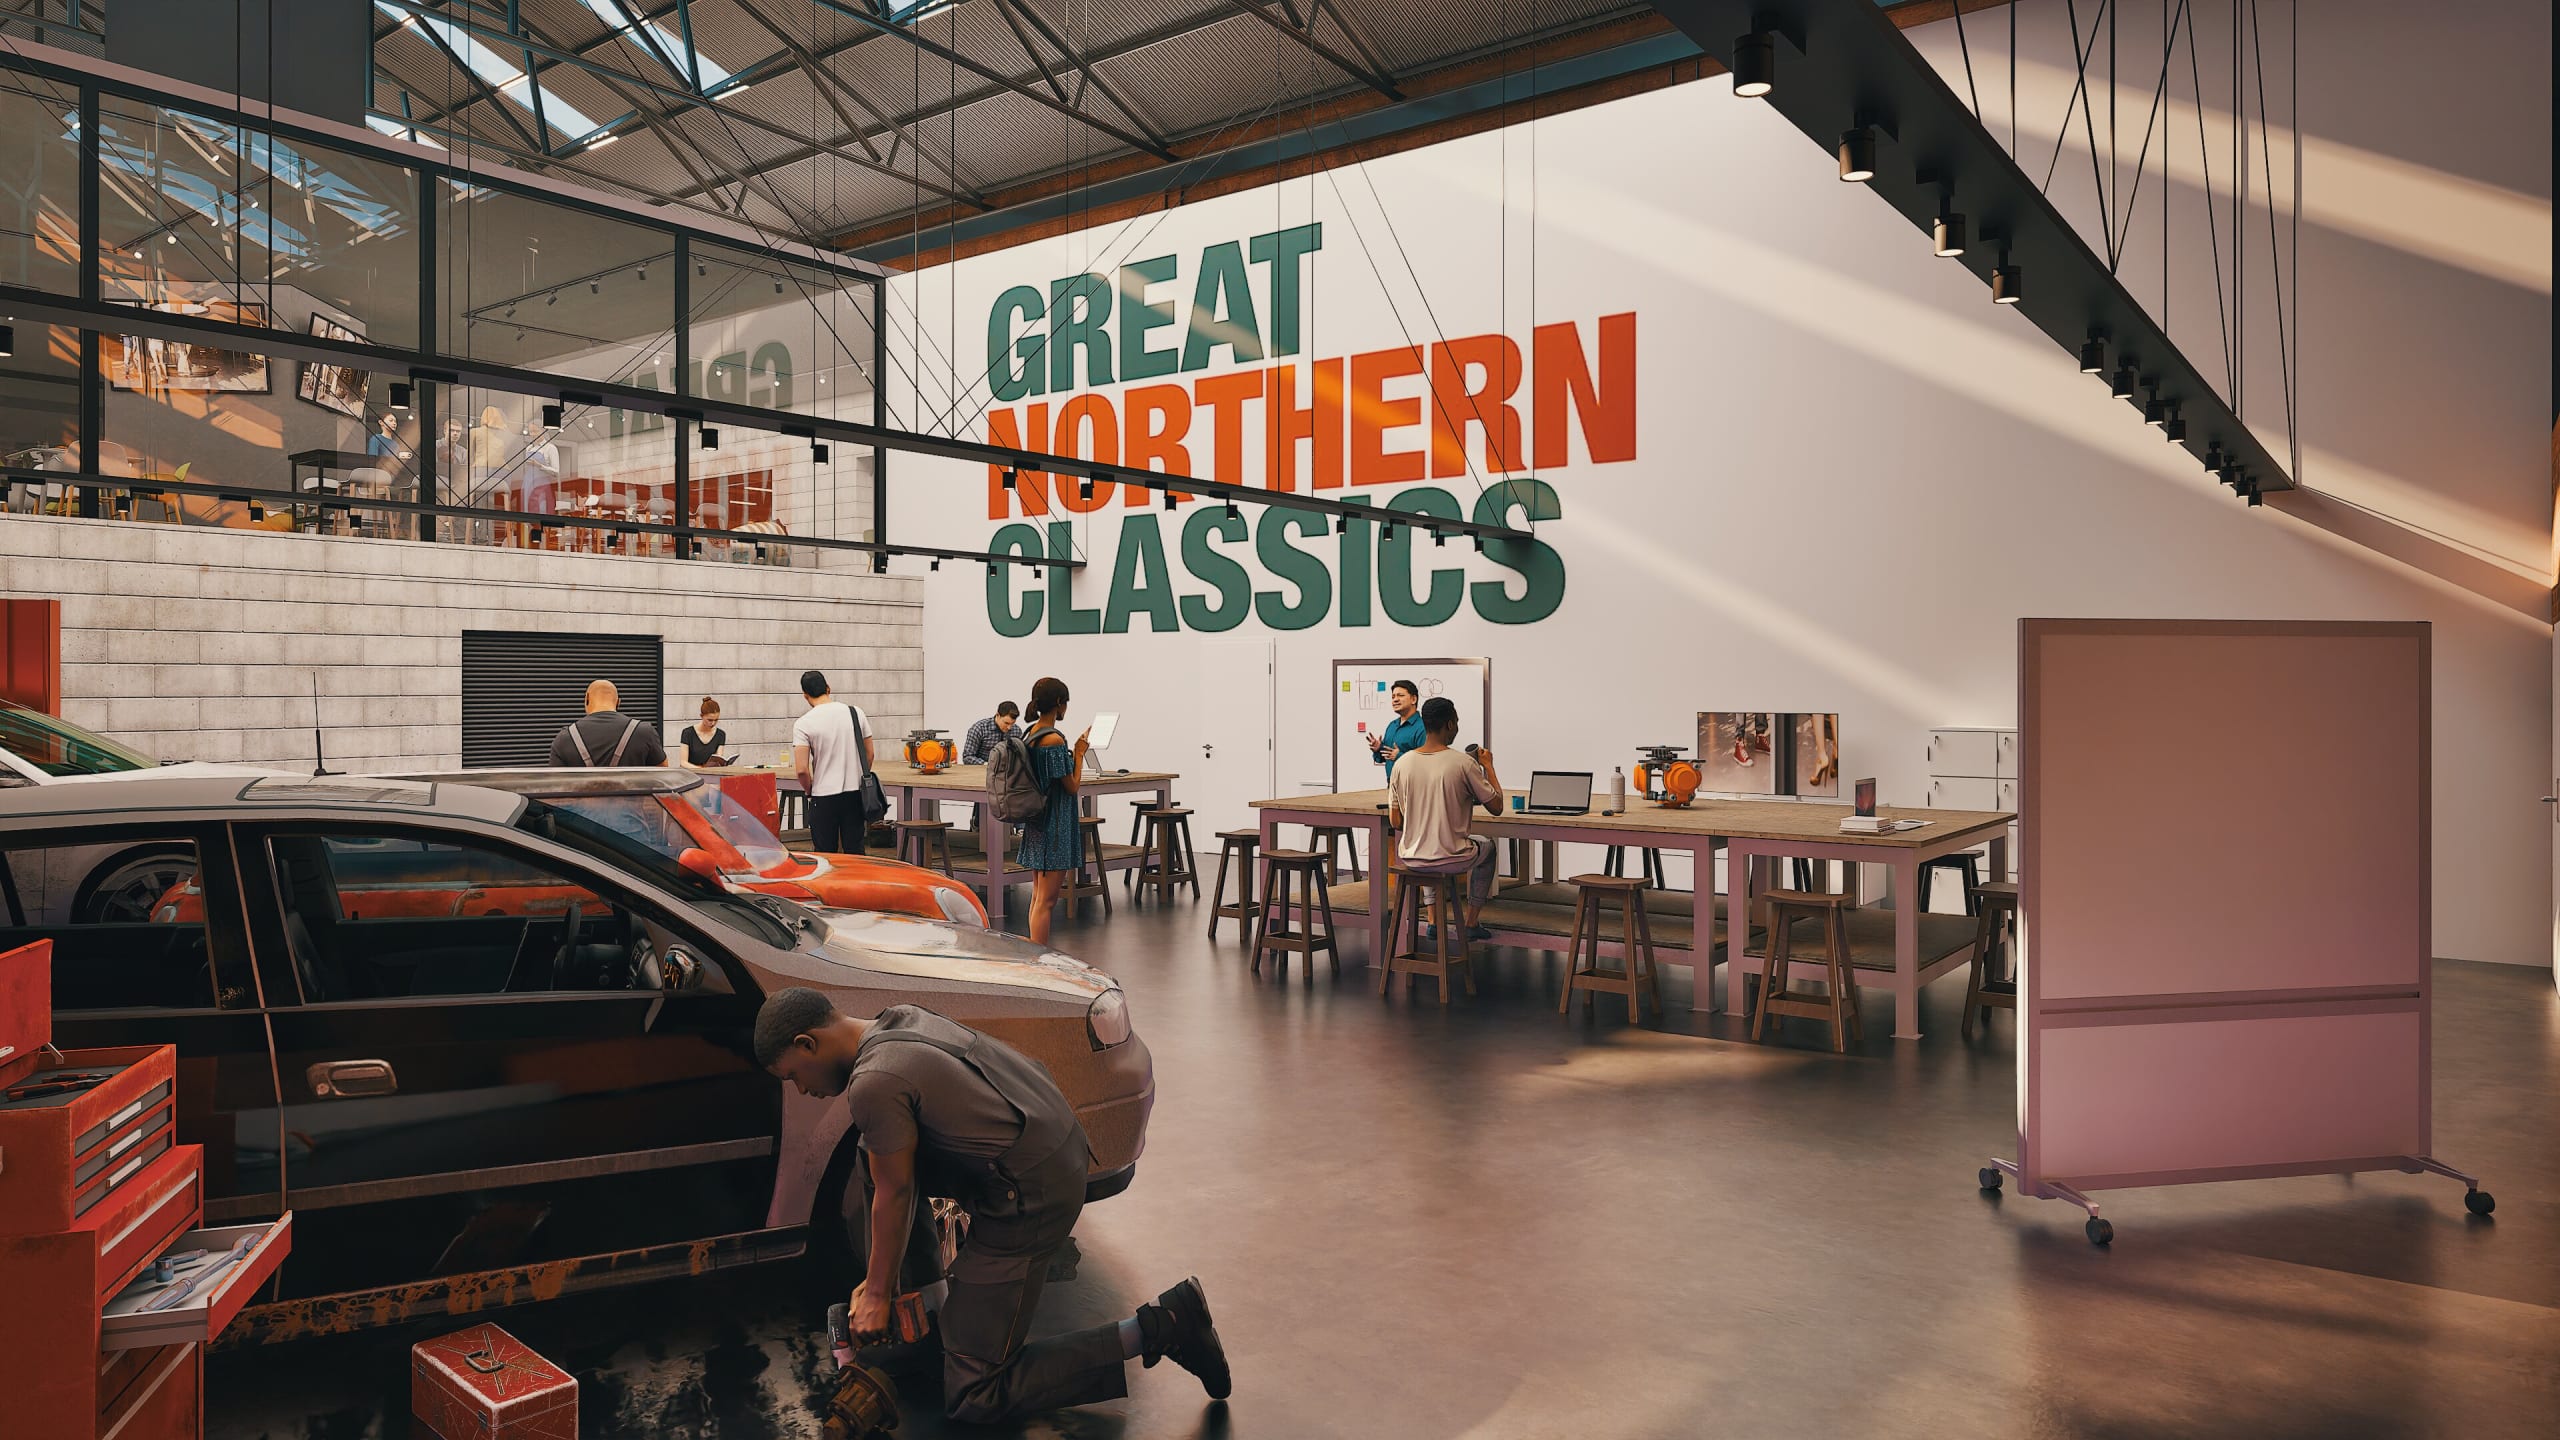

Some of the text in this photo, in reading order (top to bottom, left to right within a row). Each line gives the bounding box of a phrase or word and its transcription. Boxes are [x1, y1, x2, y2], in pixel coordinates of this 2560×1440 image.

[987, 222, 1322, 402] GREAT
[987, 312, 1637, 520] NORTHERN
[986, 478, 1566, 637] CLASSICS
